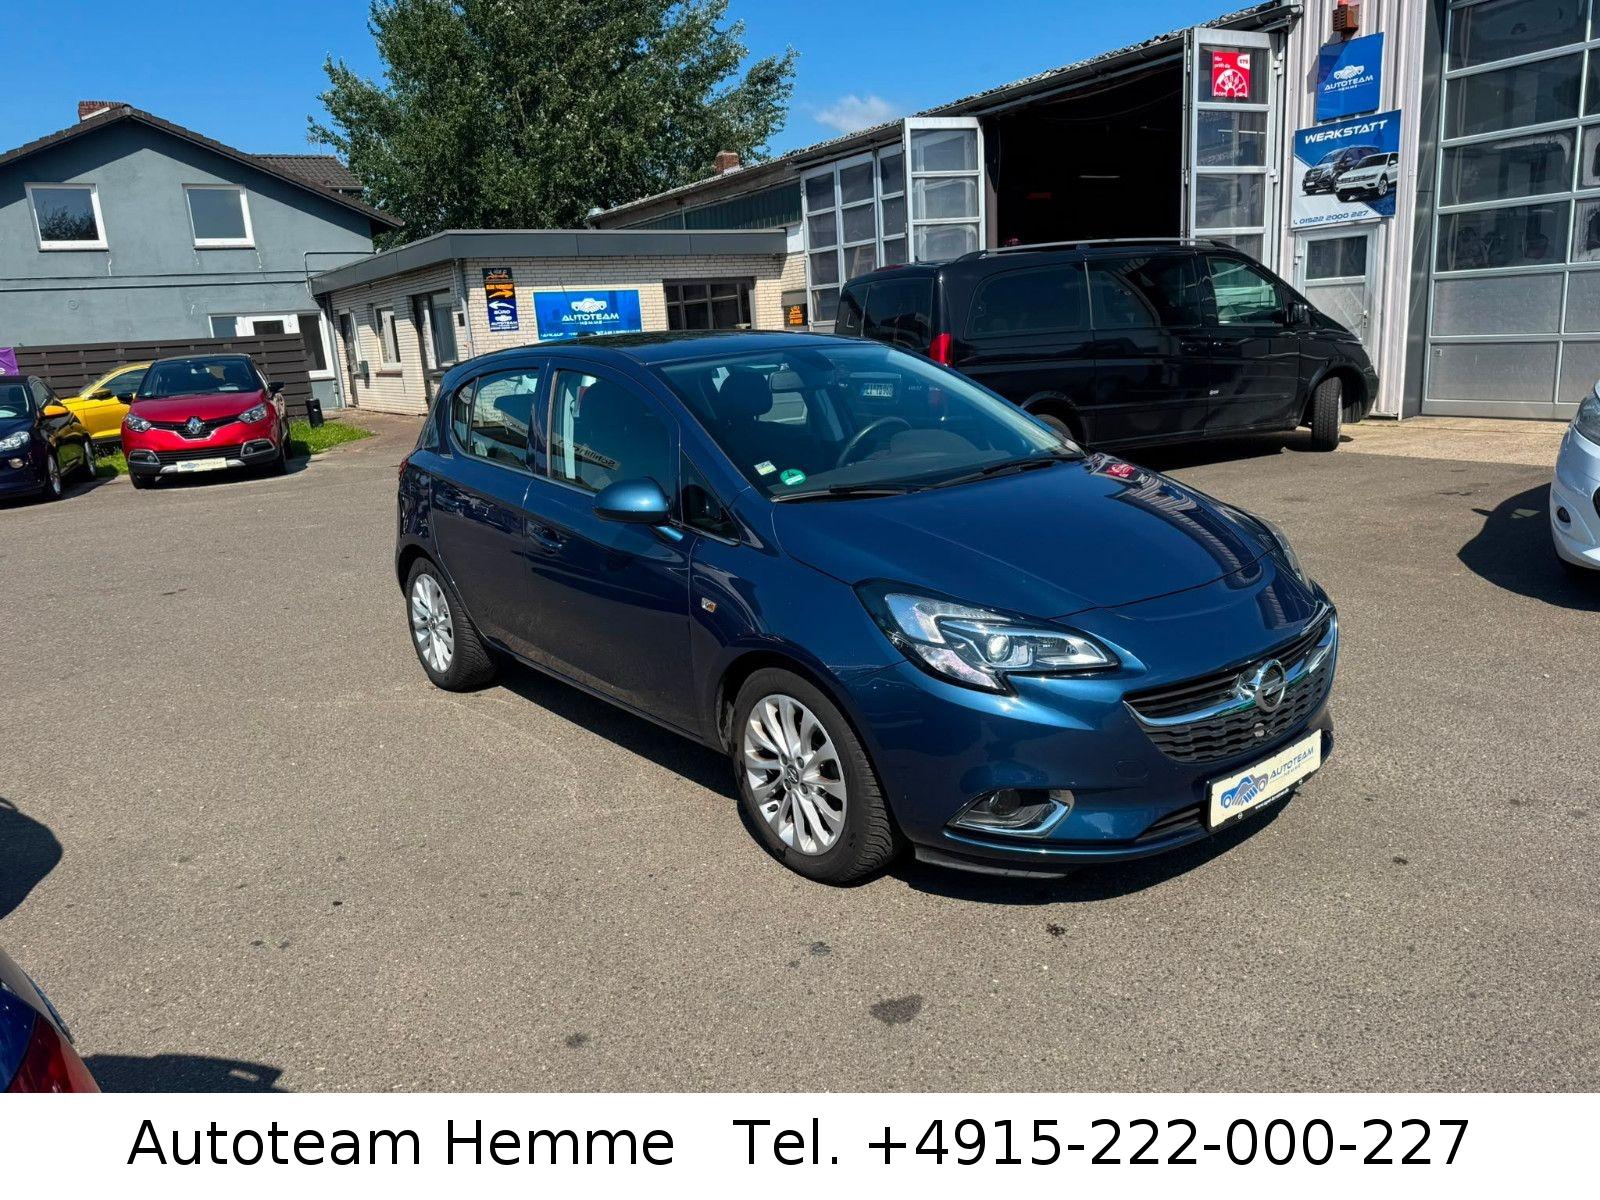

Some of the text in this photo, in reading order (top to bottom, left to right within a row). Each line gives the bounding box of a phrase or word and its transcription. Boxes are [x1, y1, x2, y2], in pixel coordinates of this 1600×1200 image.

[1324, 74, 1374, 91] AUTOTEAM
[1305, 119, 1389, 145] WERKSTATT
[1299, 209, 1370, 225] 01522 2000 227
[561, 312, 620, 322] AUTOTEAM
[1270, 746, 1314, 779] AUTOTEAM
